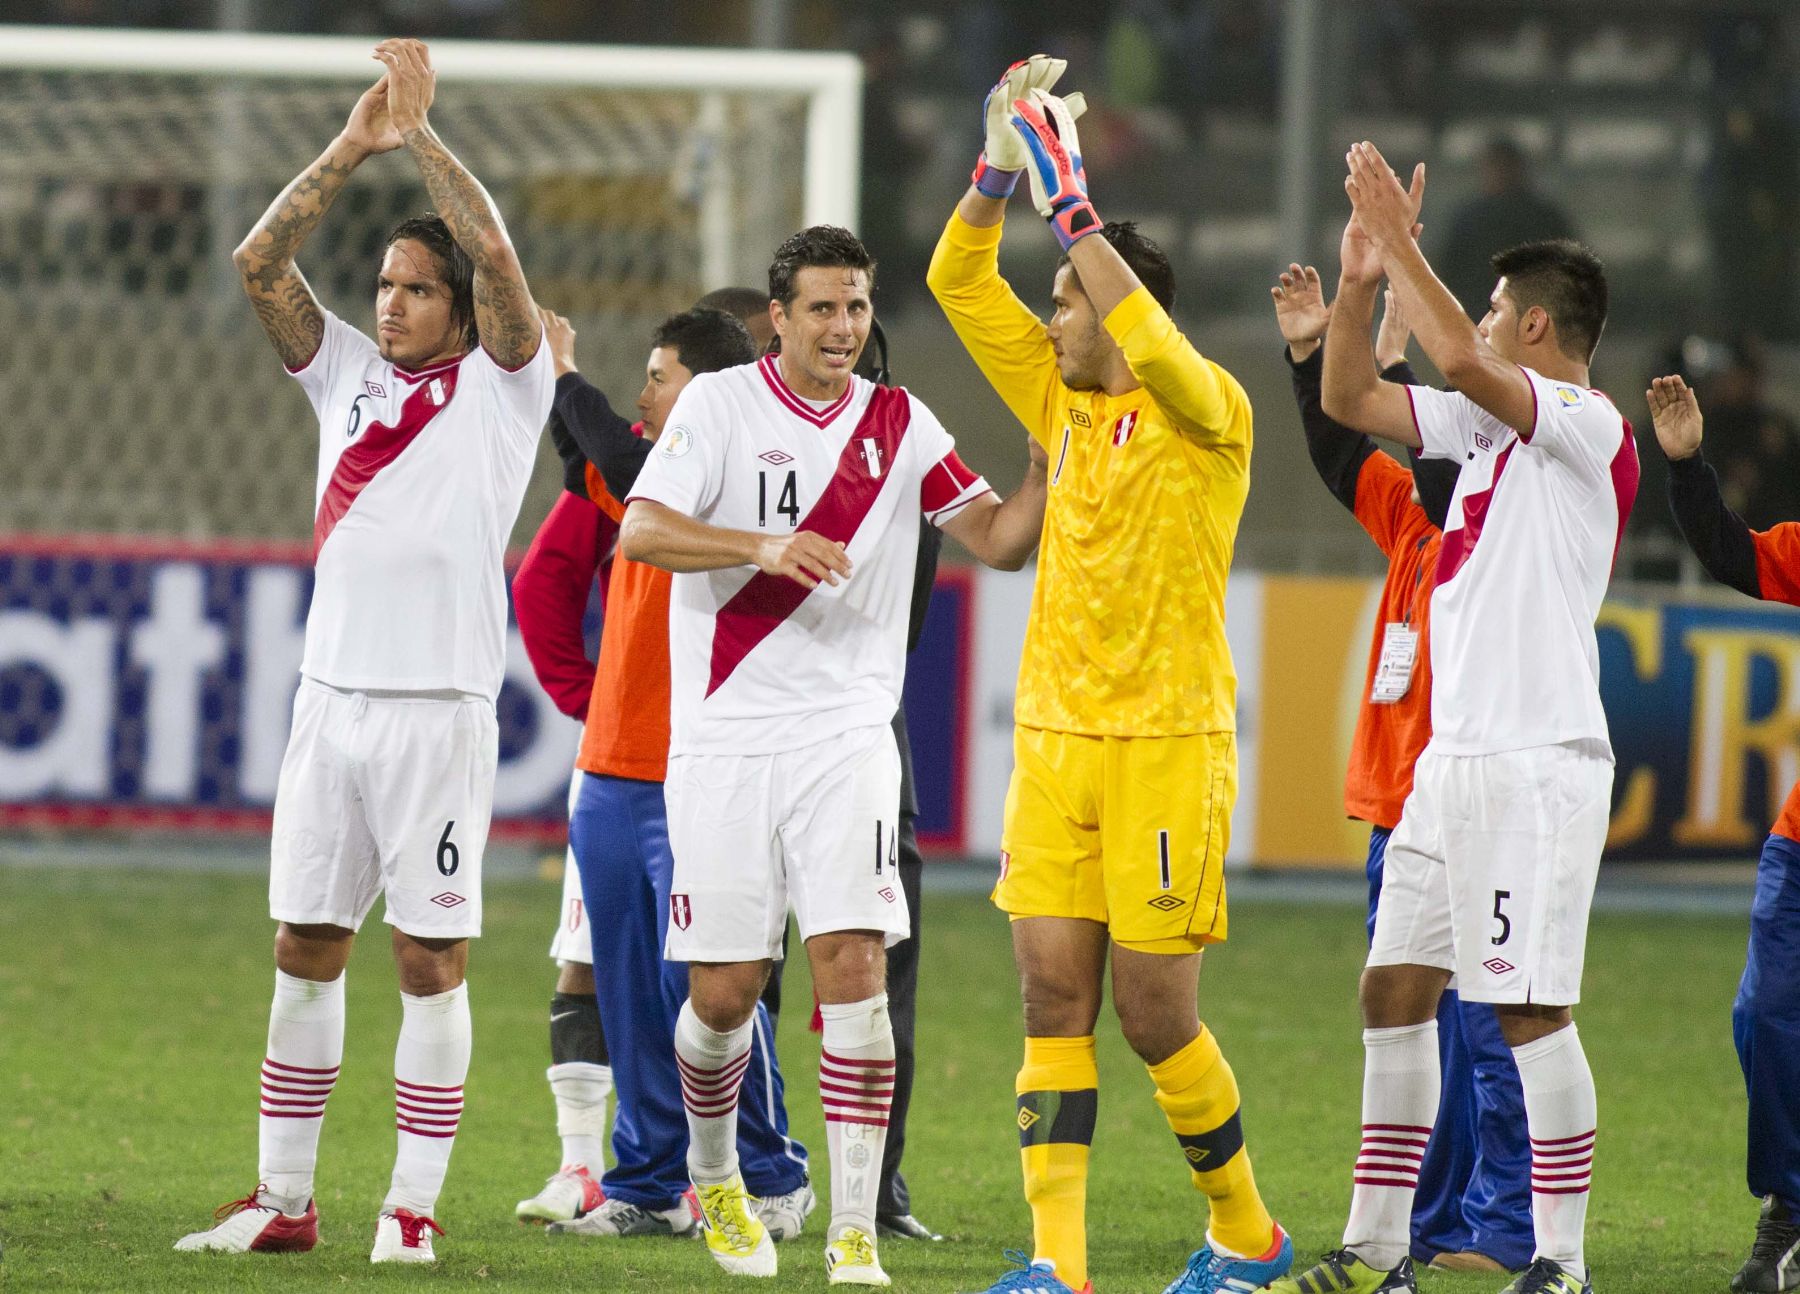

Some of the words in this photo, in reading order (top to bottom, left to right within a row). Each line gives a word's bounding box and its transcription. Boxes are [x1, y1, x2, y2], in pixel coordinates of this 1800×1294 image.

[346, 393, 372, 438] 6
[758, 470, 800, 527] 14
[436, 820, 460, 877] 6
[1159, 831, 1171, 888] 1
[1491, 889, 1511, 946] 5
